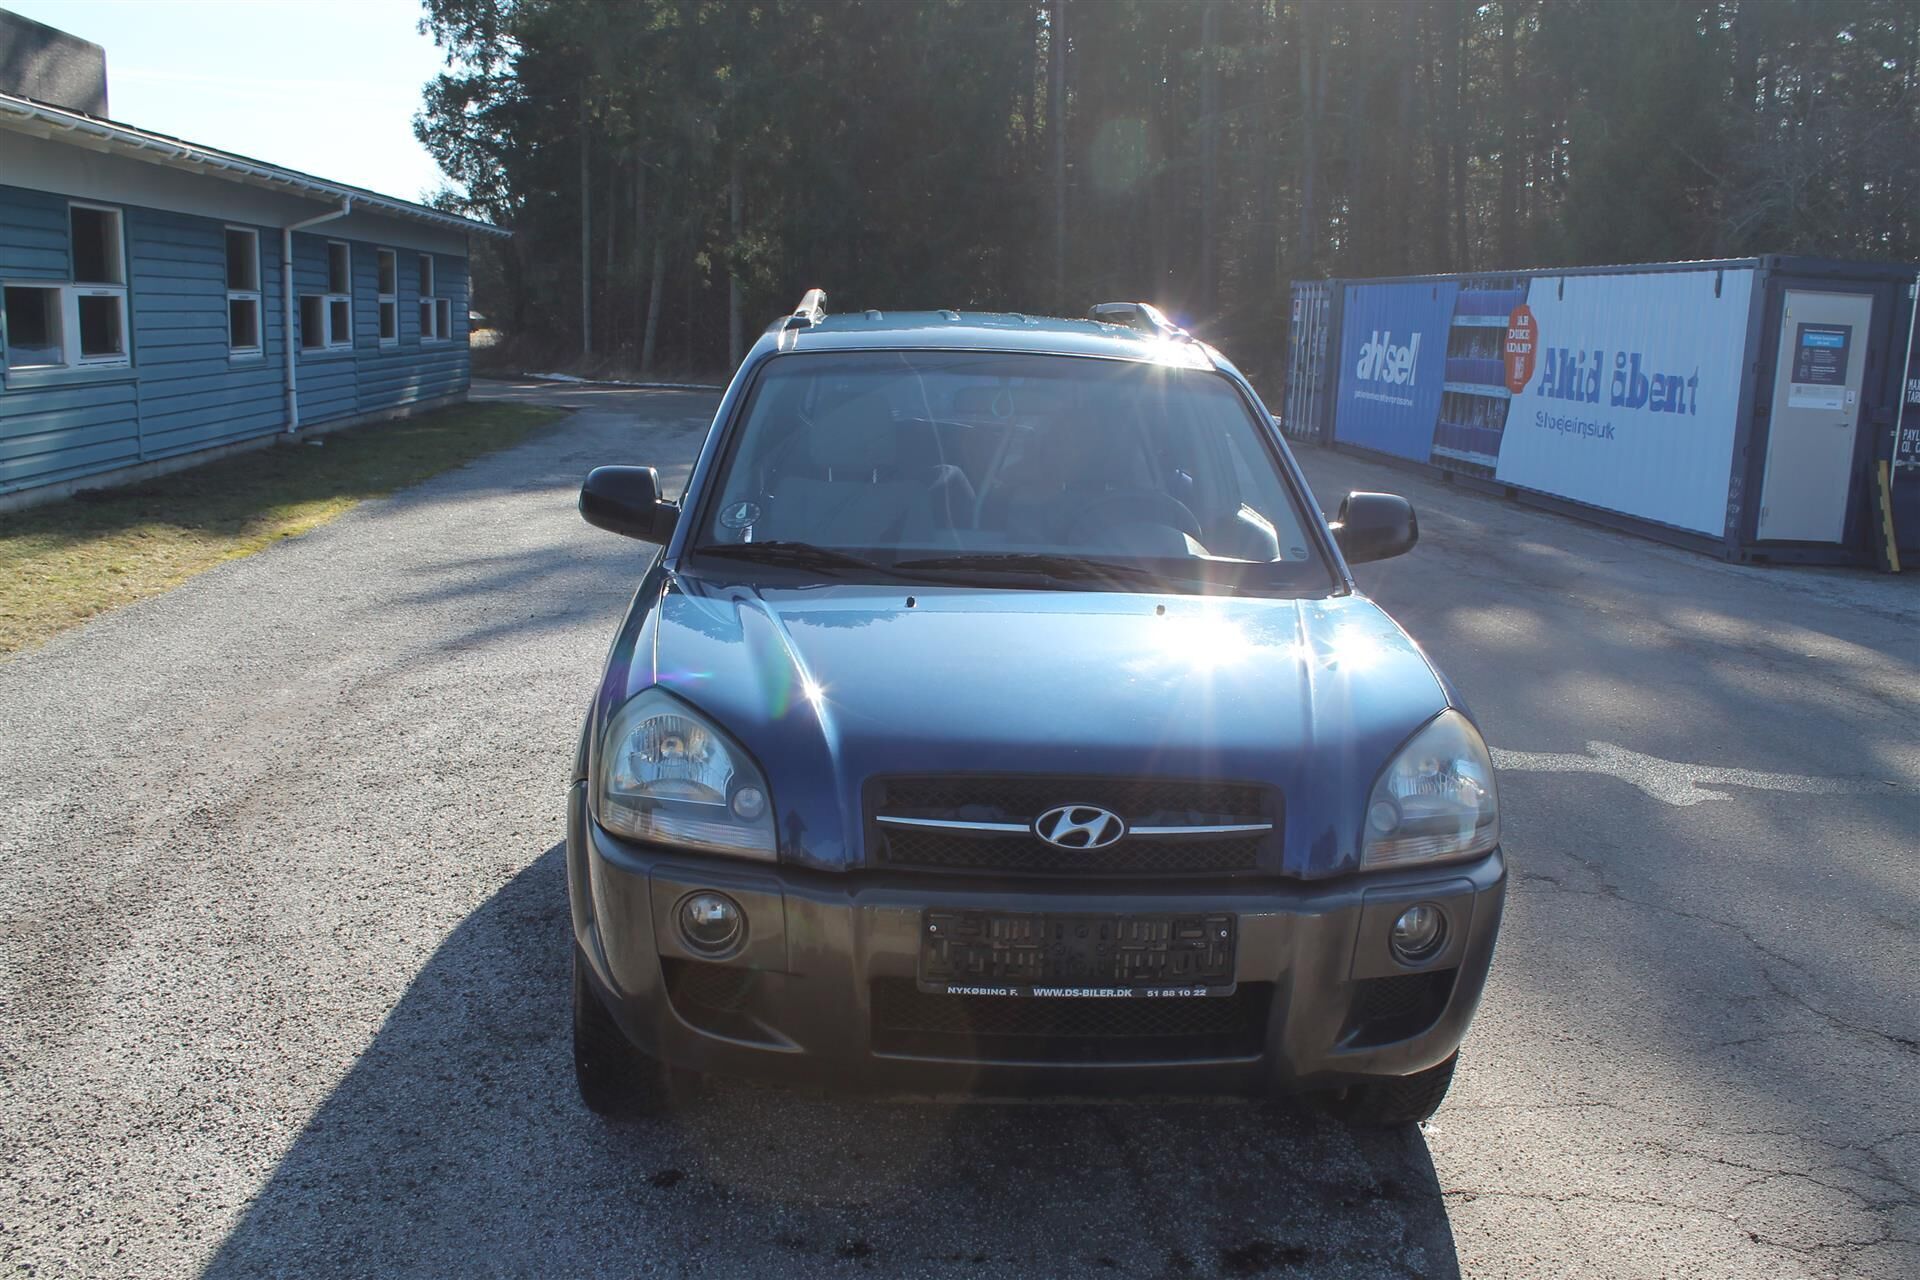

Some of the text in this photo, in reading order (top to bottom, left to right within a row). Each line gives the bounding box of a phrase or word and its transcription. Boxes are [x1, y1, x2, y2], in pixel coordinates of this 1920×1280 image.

[1537, 347, 1604, 404] Altid
[947, 986, 1007, 996] NYKØBING
[1033, 988, 1132, 998] WWW.DS-BILER.DK
